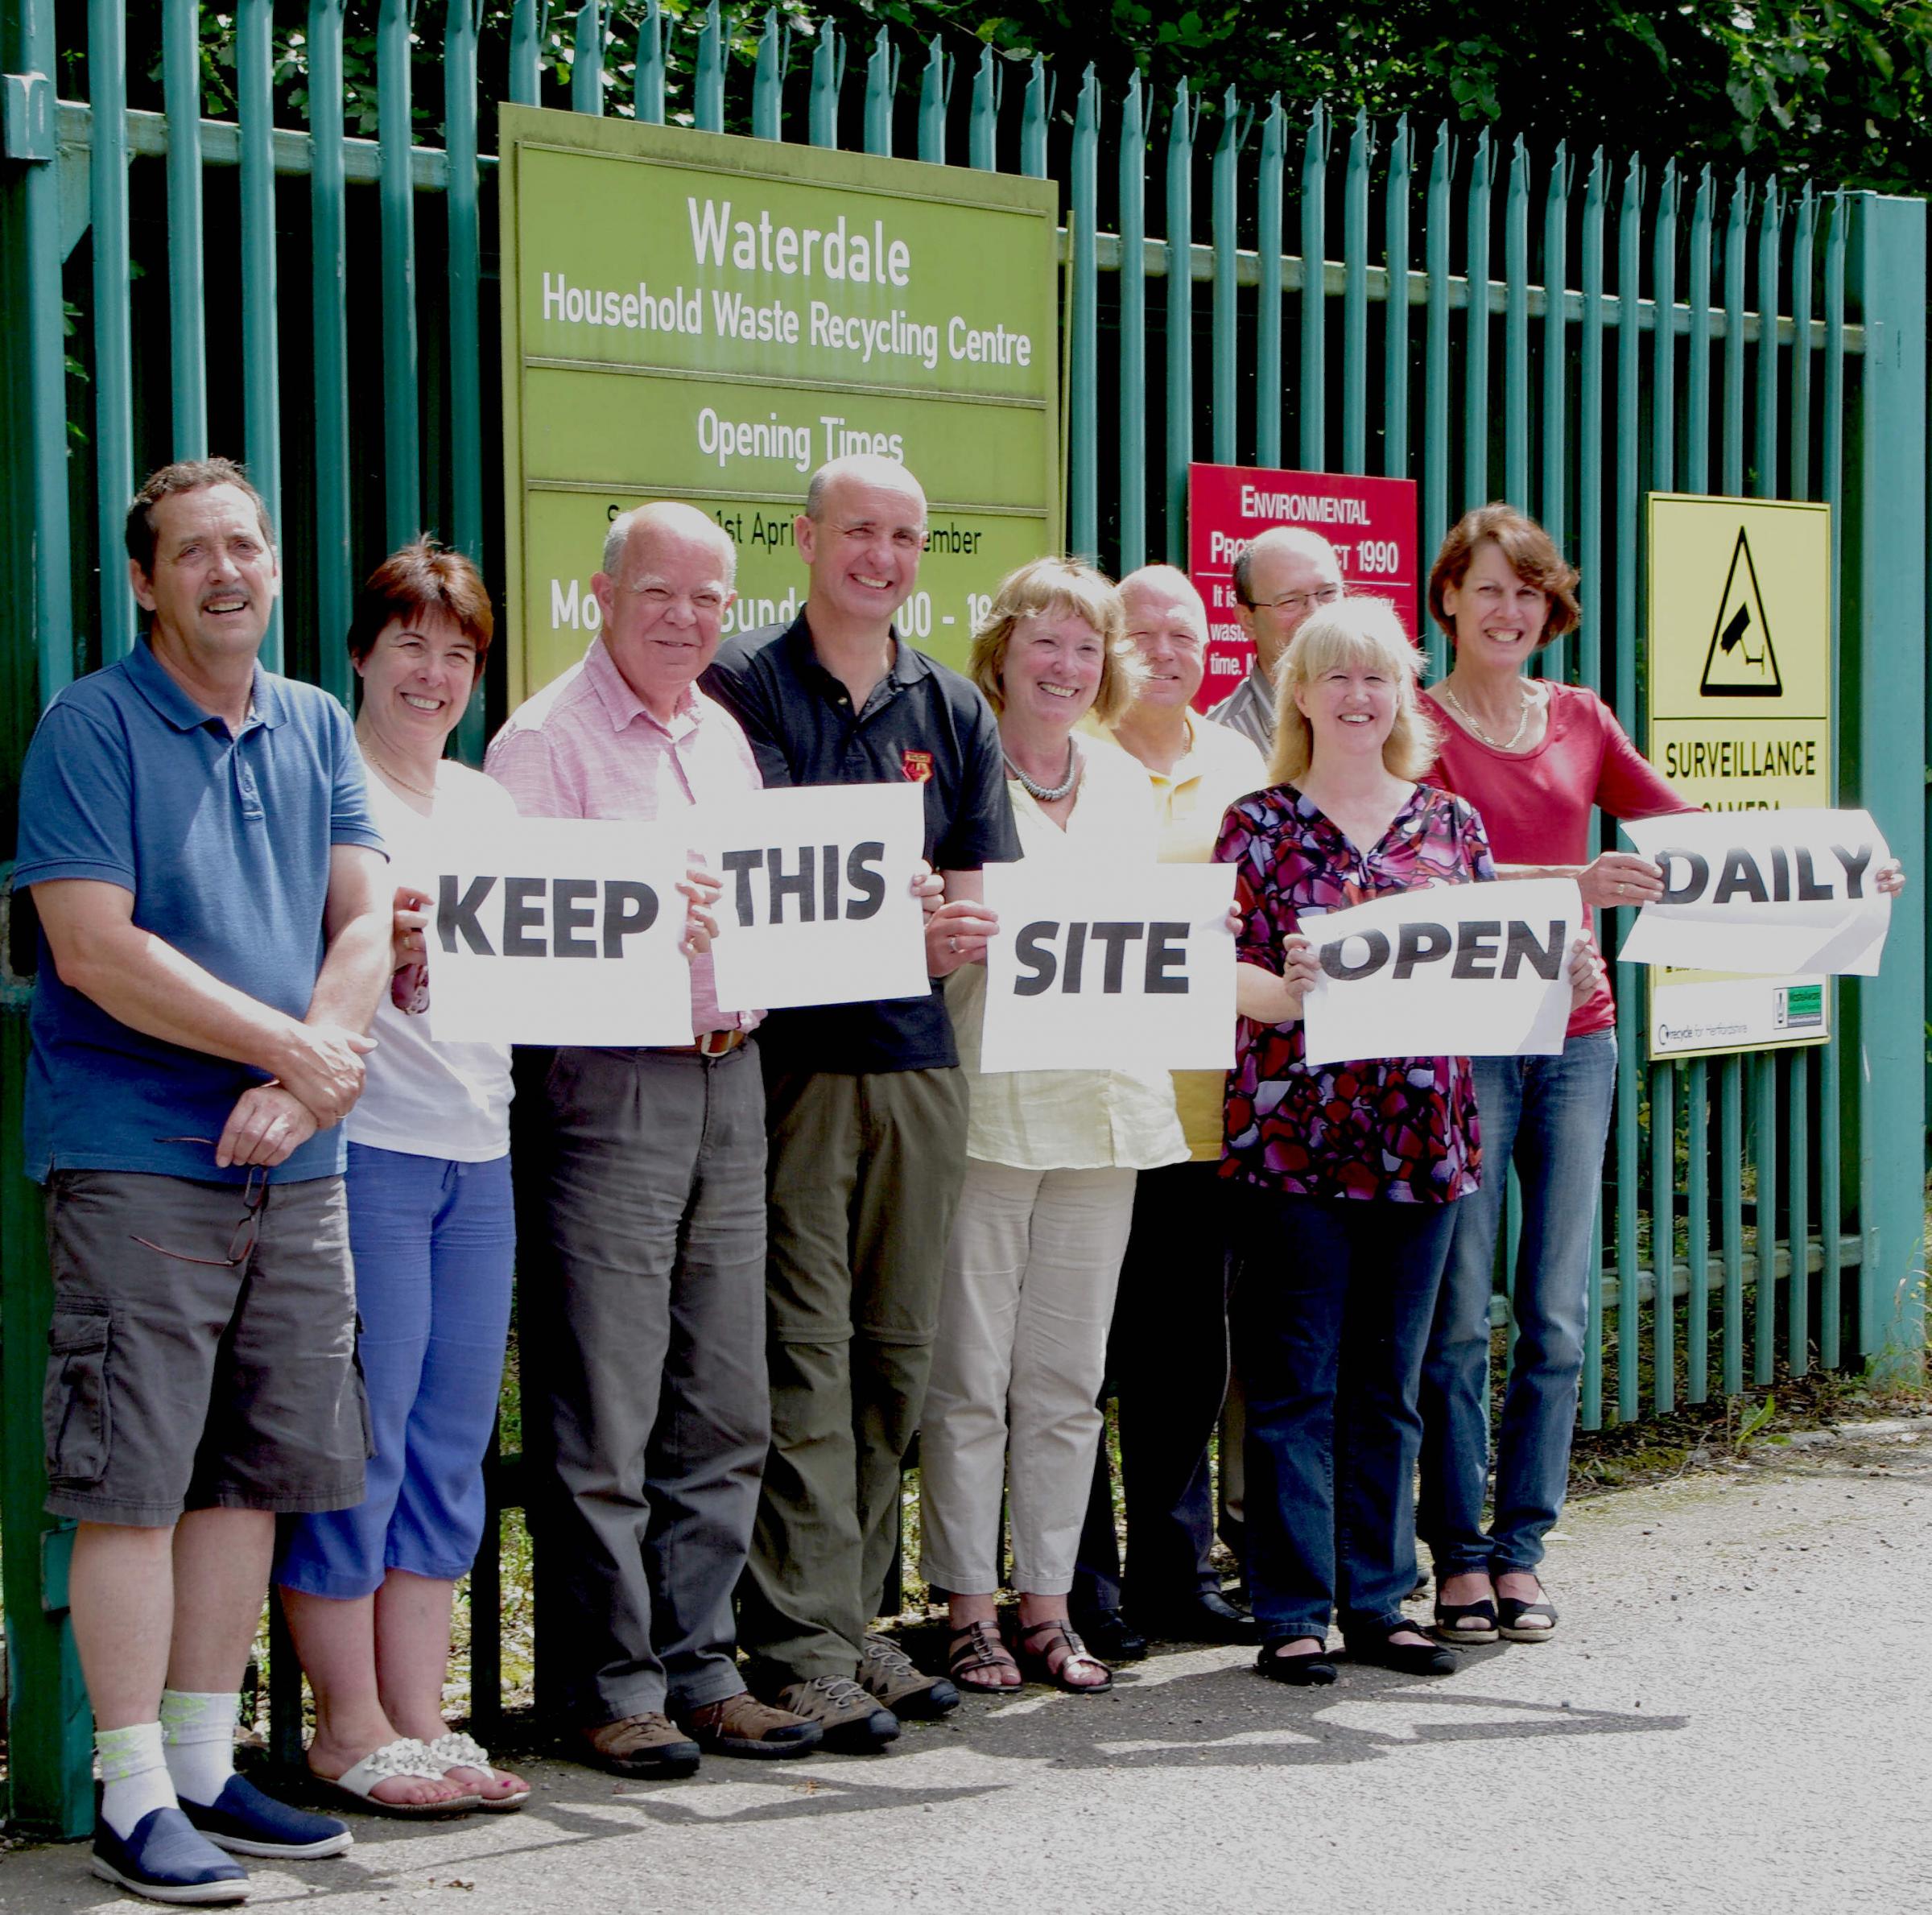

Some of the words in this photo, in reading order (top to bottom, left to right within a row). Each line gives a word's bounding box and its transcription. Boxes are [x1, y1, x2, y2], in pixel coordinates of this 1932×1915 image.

[687, 196, 911, 287] Waterdale
[543, 271, 703, 335] Household
[712, 289, 799, 345] Waste
[810, 300, 939, 369] Recycling
[948, 315, 1031, 366] Centre
[697, 407, 811, 473] Opening
[819, 415, 904, 464] Times
[750, 512, 797, 555] Apri
[923, 522, 982, 555] ember
[1241, 485, 1372, 526] ENVIRONMENTAL
[1356, 540, 1399, 574] 1990
[1212, 584, 1224, 608] It
[1210, 651, 1243, 675] time.
[1666, 740, 1817, 778] SURVEILLANCE
[722, 841, 886, 927] THIS
[1653, 844, 1873, 905] DAILY
[436, 875, 659, 959] KEEP
[1013, 920, 1191, 996] SITE
[1319, 920, 1567, 981] OPEN
